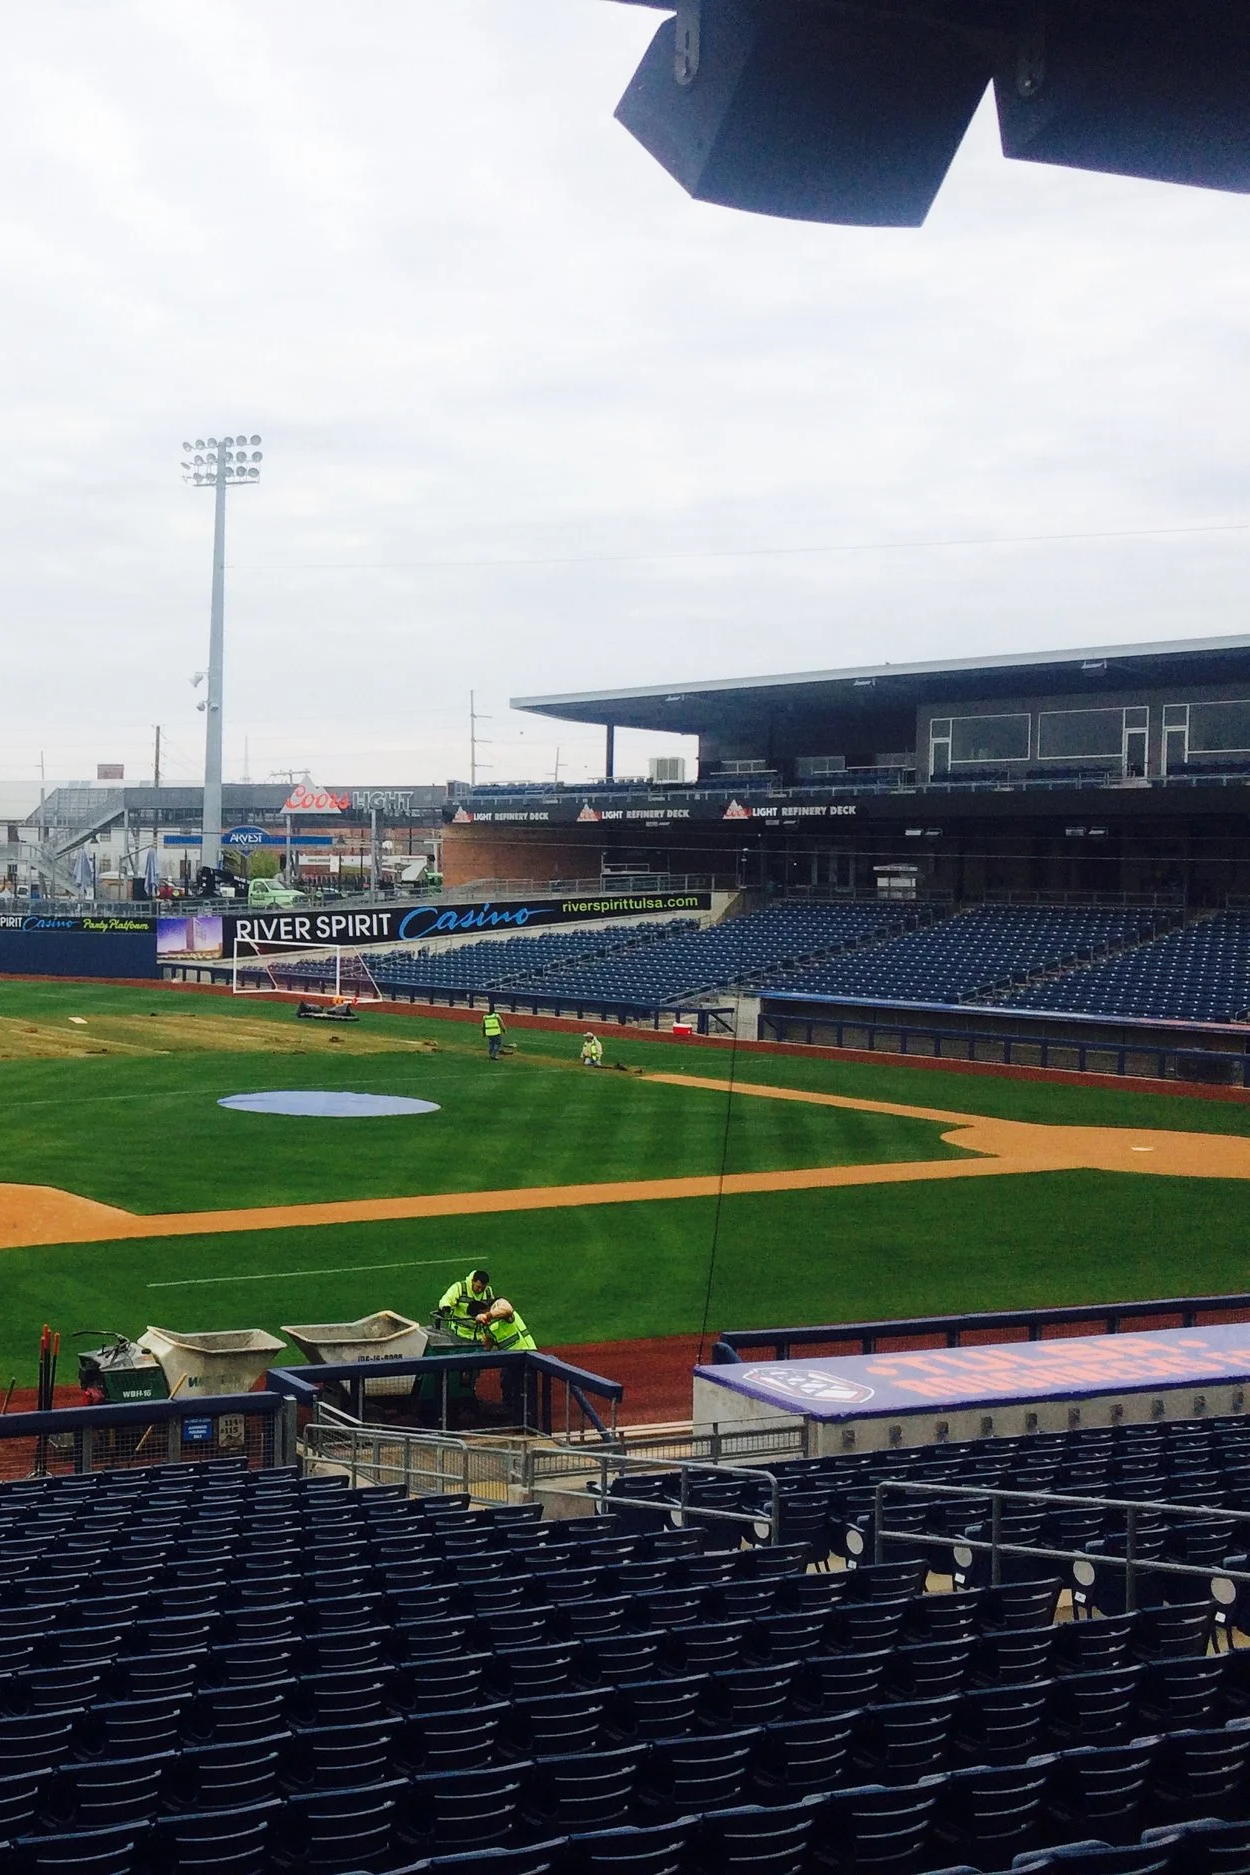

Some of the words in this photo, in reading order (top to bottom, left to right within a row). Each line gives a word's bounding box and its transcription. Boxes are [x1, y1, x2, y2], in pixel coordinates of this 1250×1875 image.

[286, 783, 350, 810] Coors
[352, 791, 414, 811] LIGHT
[473, 812, 492, 821] LIGHT
[494, 812, 528, 821] REFINERY
[530, 812, 549, 820] DECK
[601, 810, 623, 819] LIGHT
[626, 810, 665, 819] REFINERY
[667, 809, 690, 818] DECK
[752, 807, 777, 817] LIGHT
[781, 806, 827, 816] REFINERY
[830, 805, 856, 815] DECK
[229, 832, 263, 846] ARVEST
[22, 914, 81, 932] Casino
[235, 915, 313, 942] RIVER
[316, 913, 392, 938] SPIRIT
[397, 902, 555, 941] Casino
[562, 894, 698, 914] riverspirittulsa.com
[874, 1339, 1184, 1375] TULSA
